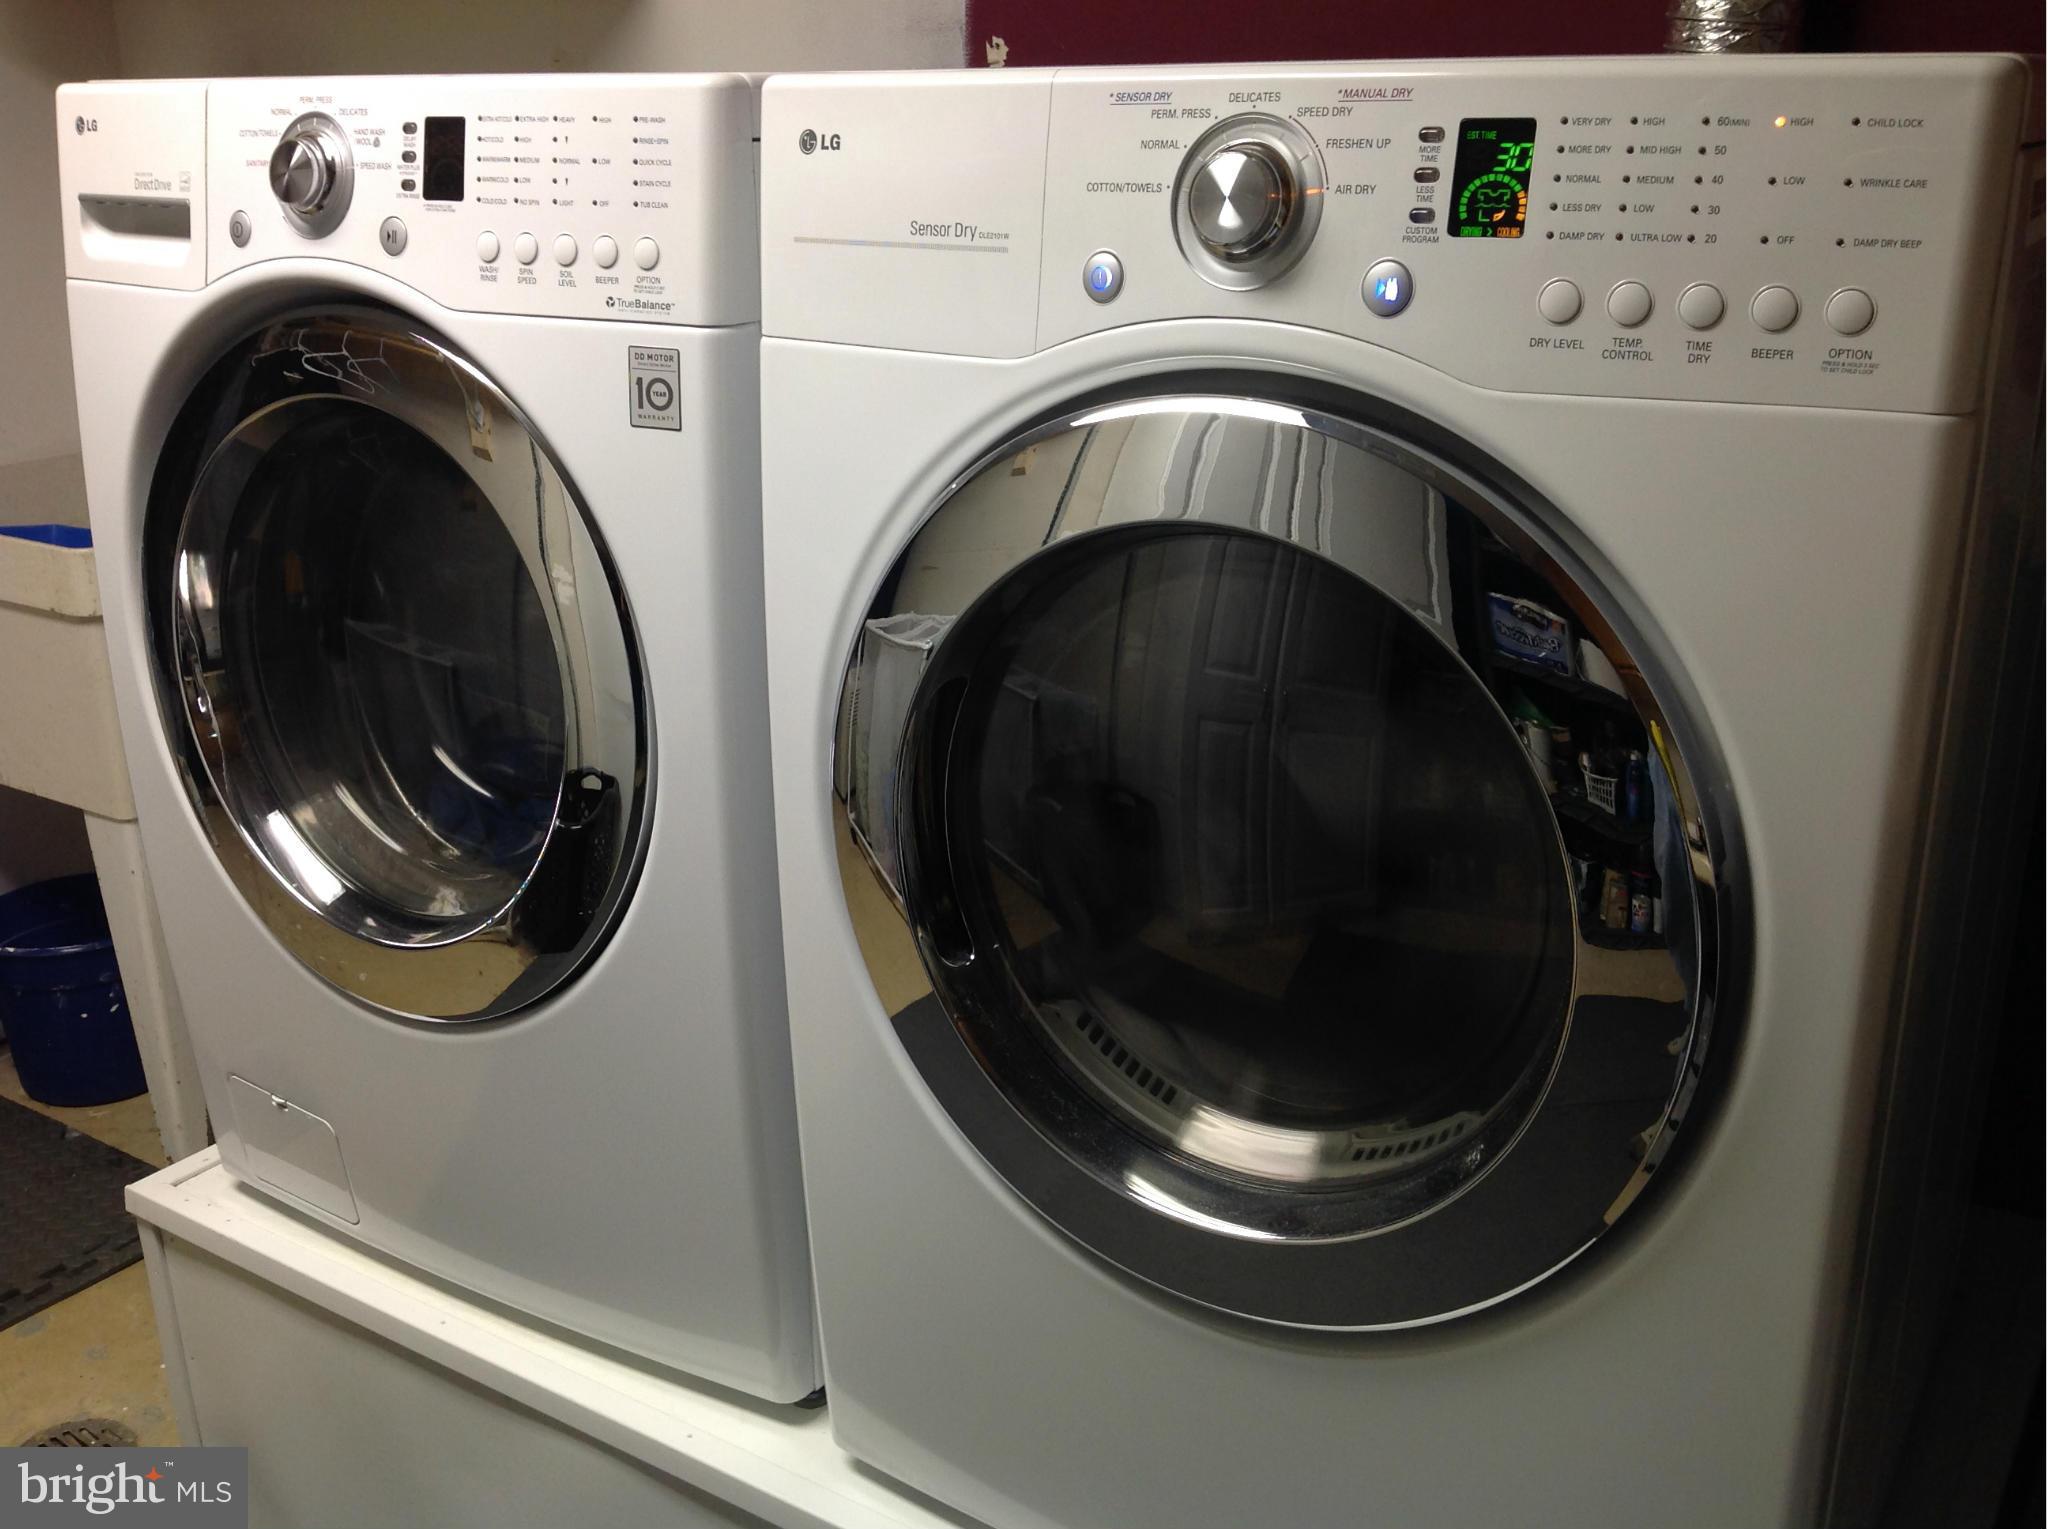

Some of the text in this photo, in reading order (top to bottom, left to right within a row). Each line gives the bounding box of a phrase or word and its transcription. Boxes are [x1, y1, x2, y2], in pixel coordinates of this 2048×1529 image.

[1151, 92, 1172, 102] DRY
[1229, 92, 1281, 103] DELICATES
[1385, 88, 1414, 98] DRY
[338, 108, 368, 116] DELICATES
[1151, 108, 1211, 119] PERM. PRESS
[1297, 106, 1353, 117] SPEED DRY
[1572, 117, 1611, 126] VERY DRY
[1643, 117, 1665, 126] HIGH
[1790, 117, 1814, 127] HIGH
[1867, 118, 1924, 128] CHILD LOCK
[1481, 131, 1497, 140] TIME
[820, 133, 841, 151] LG
[1140, 139, 1180, 150] NORMAL
[1326, 138, 1391, 149] FRESHEN UP
[1418, 145, 1441, 154] MORE
[1568, 146, 1612, 154] MORE DRY
[1639, 146, 1682, 155] MID HIGH
[1714, 145, 1727, 155] 50
[1420, 155, 1439, 163] TIME
[1492, 142, 1534, 172] 30
[360, 162, 392, 170] SPEED WASH
[1565, 175, 1602, 184] NORMAL
[1636, 176, 1674, 185] MEDIUM
[1711, 175, 1724, 185] 40
[1783, 176, 1806, 185] LOW
[1860, 178, 1928, 189] WRINKLE CARE
[1086, 182, 1162, 193] COTTON/TOWELS
[1335, 184, 1376, 195] AIR DRY
[1416, 185, 1435, 194] LESS
[1416, 195, 1434, 203] TIME
[1562, 204, 1602, 213] LESS DRY
[1633, 204, 1655, 213] LOW
[1707, 205, 1720, 215] 30
[910, 220, 952, 237] Sensor
[954, 222, 978, 242] Dry
[1405, 226, 1438, 234] CUSTOM
[1497, 227, 1520, 238] COOLING
[1402, 235, 1440, 243] PROGRAM
[1558, 232, 1606, 241] DAMP DRY
[1630, 233, 1683, 243] ULTRA LOW
[1704, 234, 1717, 244] 20
[1777, 236, 1795, 245] OFF
[1853, 238, 1922, 249] DAMP DRY BEEP
[519, 268, 534, 276] SPIN
[559, 270, 573, 278] SOIL
[480, 273, 498, 282] RINSE
[517, 276, 537, 285] SPEED
[595, 276, 620, 285] BEEPER
[636, 276, 661, 285] OPTION
[558, 279, 577, 288] LEVEL
[1529, 338, 1585, 350] DRY LEVEL
[1686, 341, 1713, 352] TIME
[634, 352, 674, 363] DD MOTOR
[1601, 349, 1654, 361] CONTROL
[1687, 353, 1711, 364] DRY
[1751, 348, 1794, 360] BEEPER
[1828, 348, 1873, 360] OPTION
[635, 376, 674, 412] 10
[638, 413, 674, 422] WARRANTY
